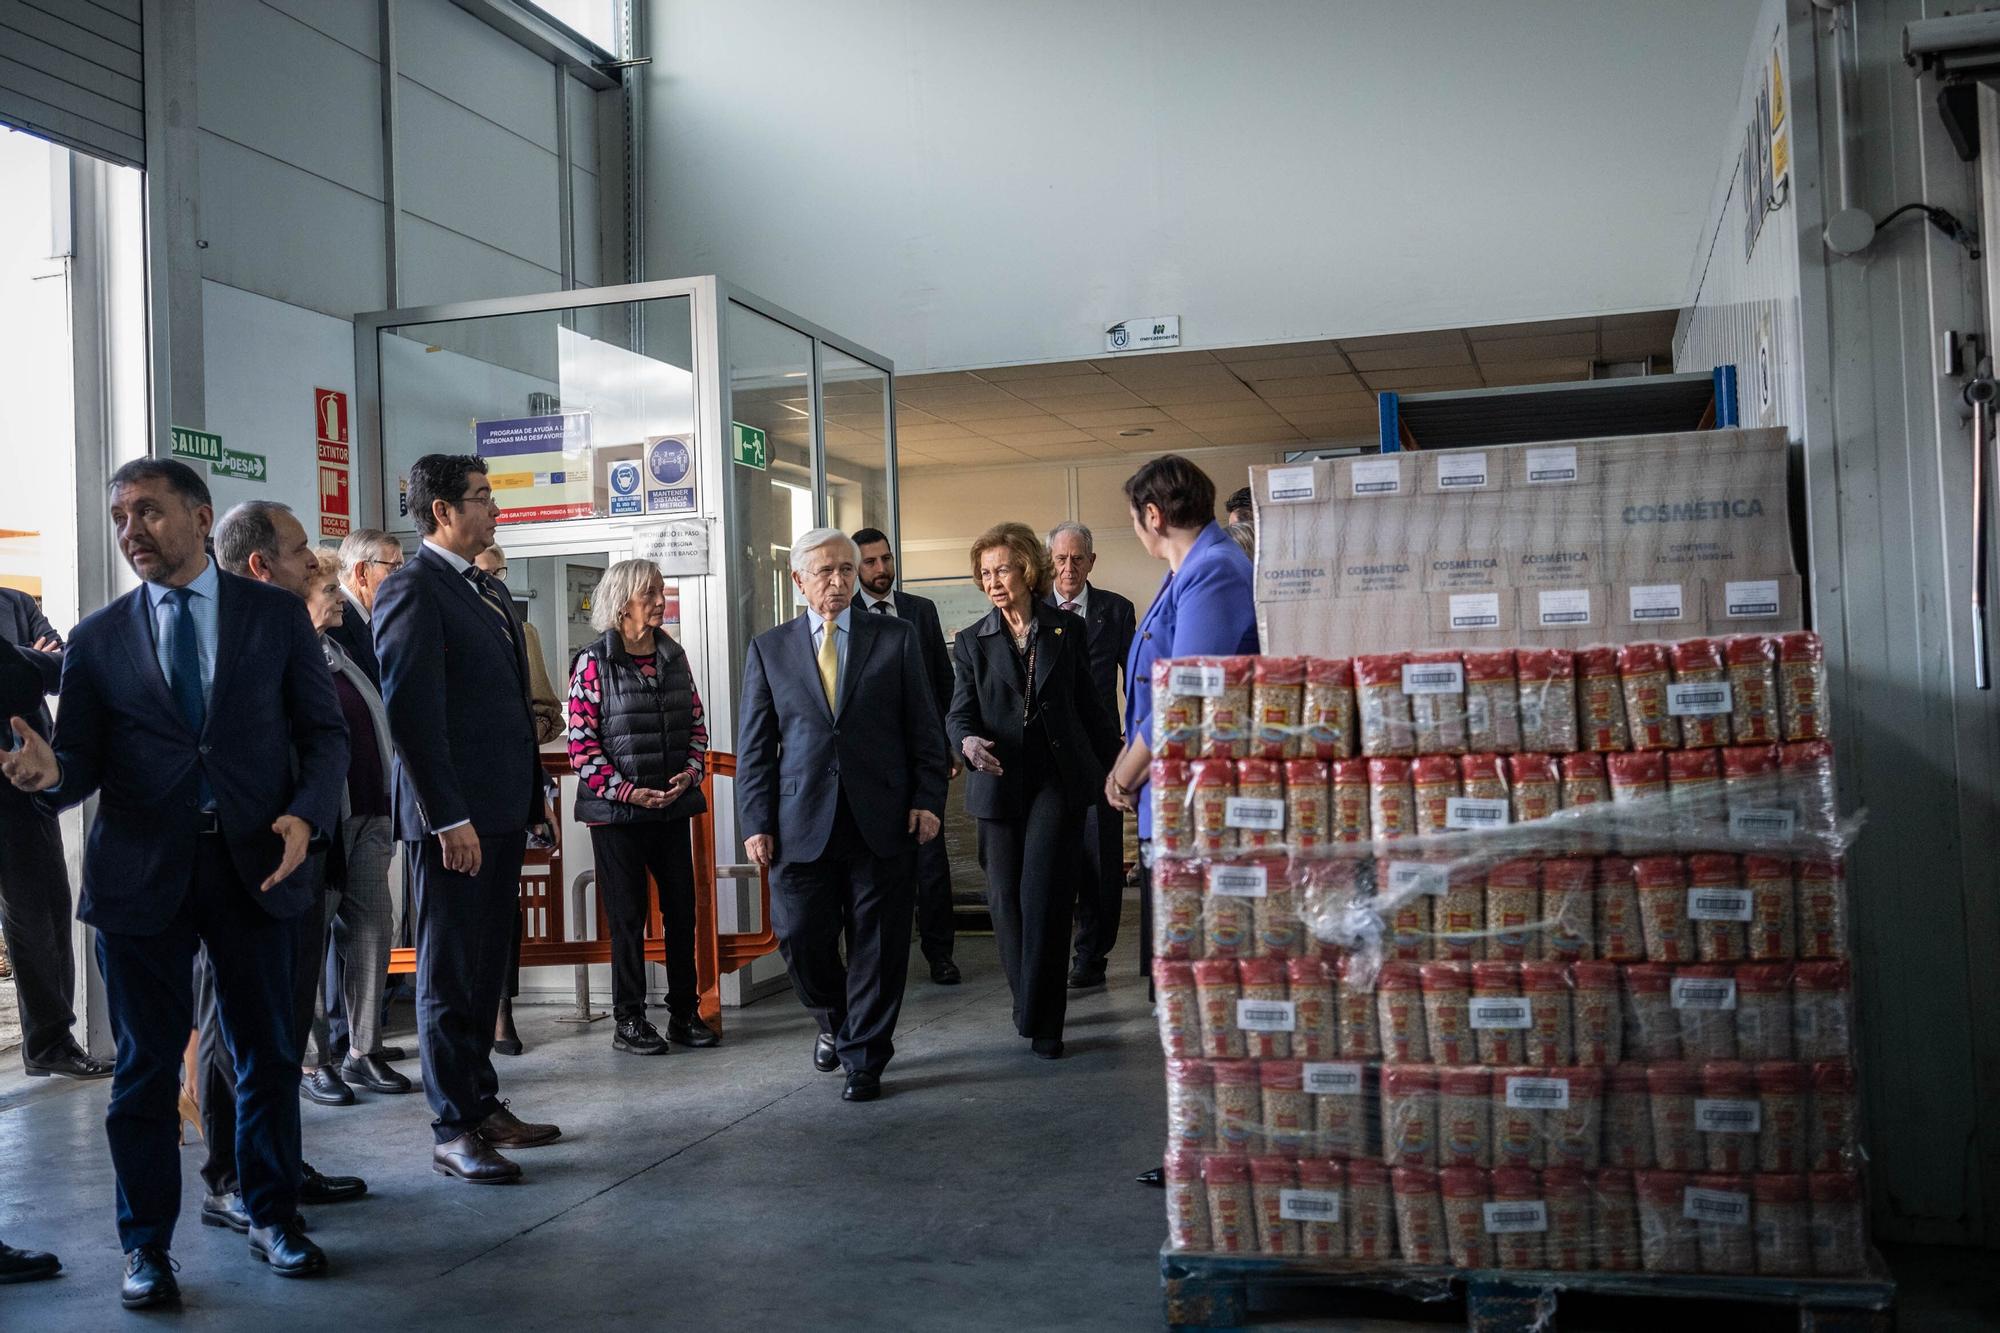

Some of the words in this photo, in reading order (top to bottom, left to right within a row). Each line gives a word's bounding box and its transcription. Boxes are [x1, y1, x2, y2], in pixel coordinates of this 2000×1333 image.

[490, 428, 523, 437] PROGRAMA
[533, 425, 553, 433] AYUDA
[171, 431, 218, 457] SALIDA
[483, 436, 514, 445] PERSONAS
[515, 434, 528, 442] MÁS
[319, 444, 349, 460] EXTINTOR
[230, 457, 254, 474] DESA
[653, 489, 689, 497] MANTENER
[654, 495, 688, 503] DISTANCIA
[660, 501, 687, 509] METROS
[509, 510, 537, 519] GRATUITOS
[540, 509, 566, 517] PROHIBIDA
[340, 520, 348, 528] DE
[323, 527, 348, 536] INCENDIO
